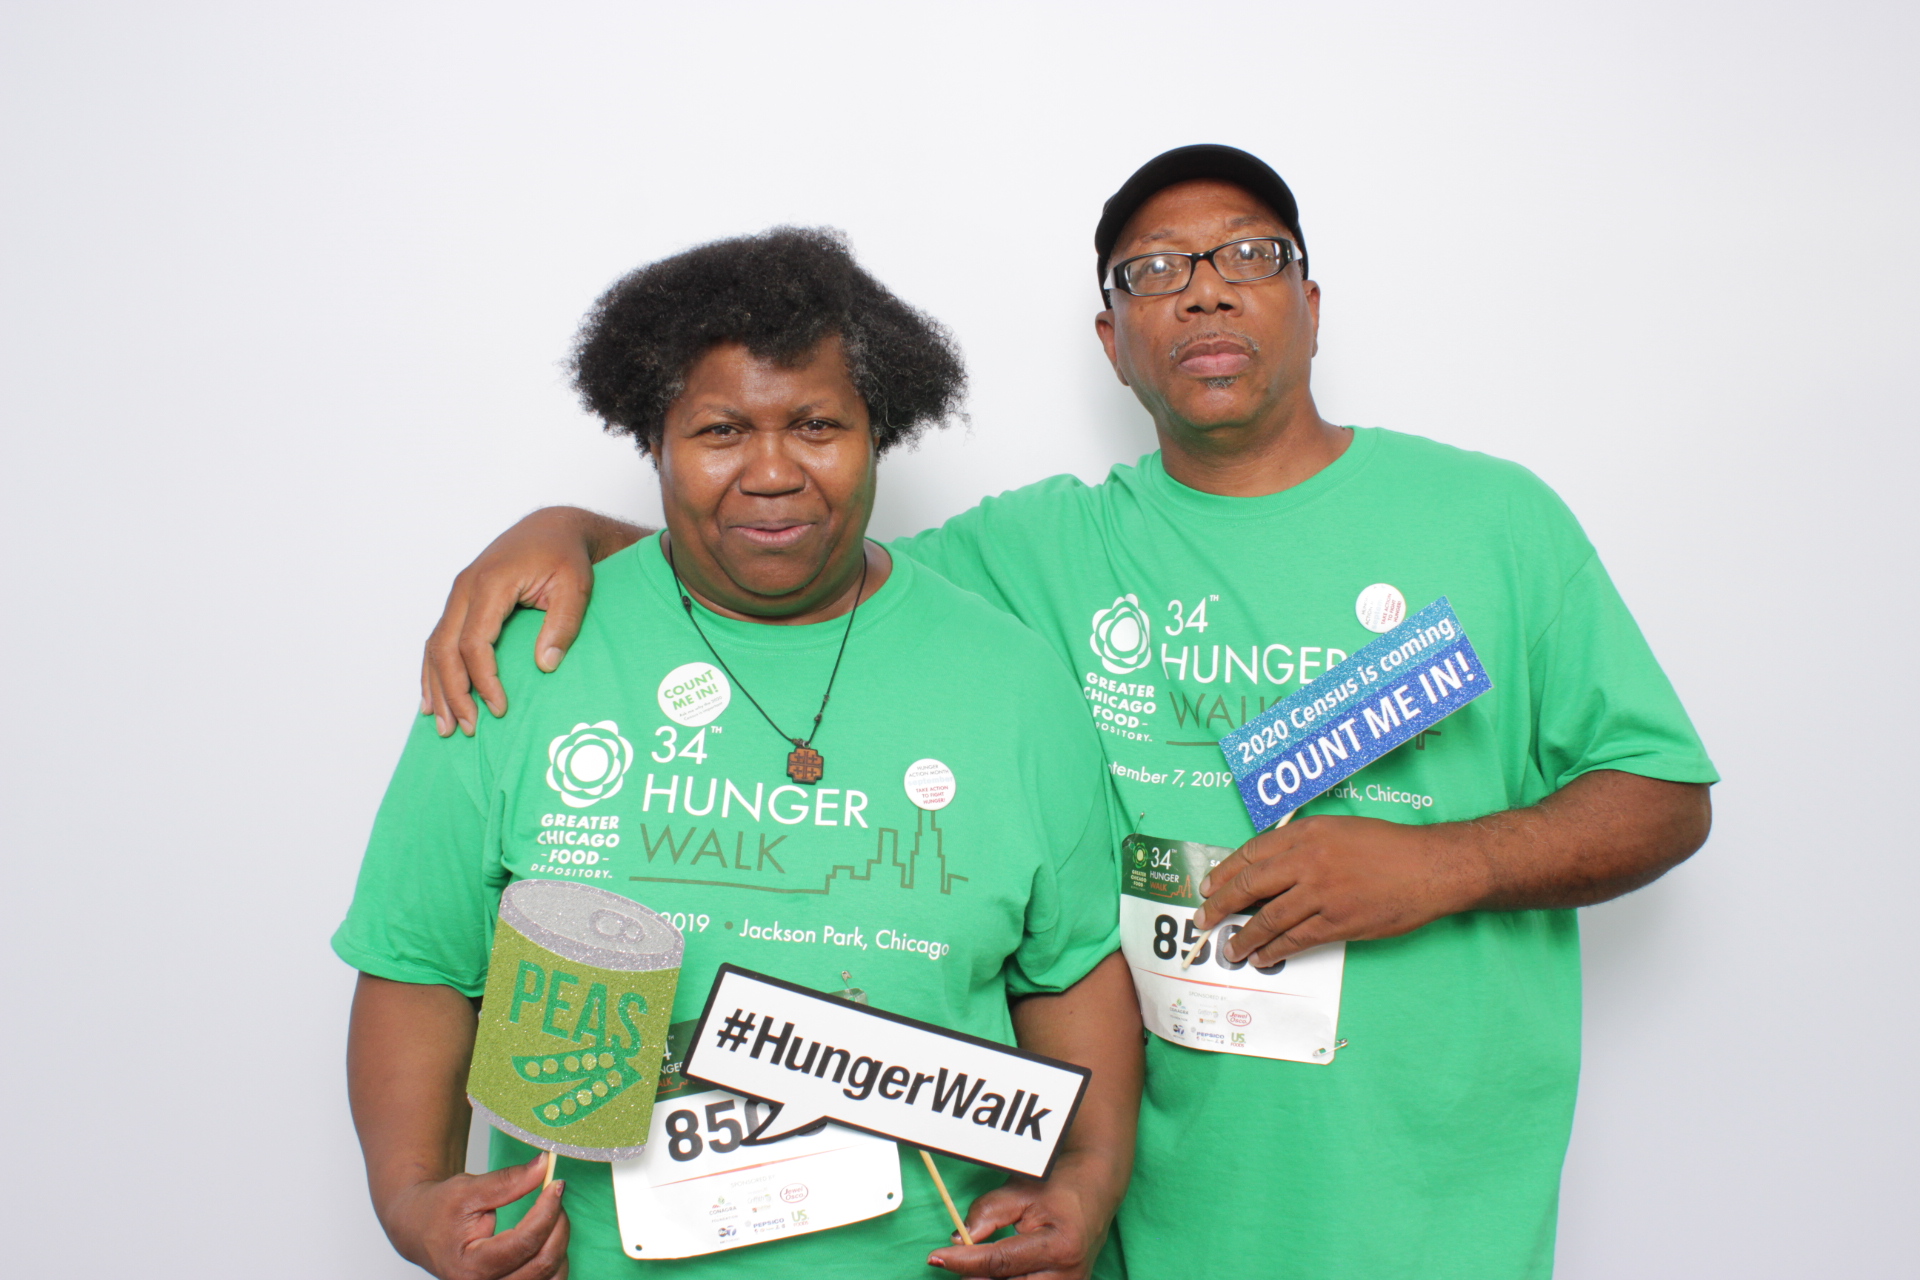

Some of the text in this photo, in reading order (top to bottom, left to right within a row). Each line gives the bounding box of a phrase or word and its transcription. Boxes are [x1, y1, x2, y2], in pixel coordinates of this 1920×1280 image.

[1380, 593, 1392, 625] TAKE ACTION
[663, 669, 714, 699] COUNT
[672, 683, 719, 711] ME IN!
[1086, 672, 1155, 698] GREATER
[1238, 617, 1456, 764] 2020 Census is coming
[1084, 686, 1156, 714] CHICAGO
[1092, 704, 1140, 729] FOOD
[1257, 650, 1475, 806] COUNT ME IN!
[1096, 722, 1150, 742] POSITORY
[1108, 761, 1234, 788] tember 7, 2019
[642, 773, 868, 828] HUNGER
[1366, 784, 1433, 810] Chicago
[540, 813, 620, 830] GREATER
[536, 830, 620, 848] CHICAGO
[640, 823, 788, 874] WALK
[548, 849, 600, 865] FOOD
[530, 864, 609, 879] DEPOSITORY
[1150, 871, 1180, 883] HUNGER
[1150, 881, 1168, 891] WALK
[739, 918, 816, 944] Jackson
[823, 925, 868, 951] Park,
[875, 929, 950, 960] Chicago
[1153, 914, 1286, 976] 850
[508, 960, 649, 1059] PEAS
[660, 1062, 683, 1075] NGE
[715, 1008, 1053, 1141] #HungerWalk
[658, 1077, 673, 1087] ALK
[784, 1186, 803, 1195] Jewel
[709, 1206, 737, 1216] CONAGRA
[753, 1217, 785, 1228] PEPSICO
